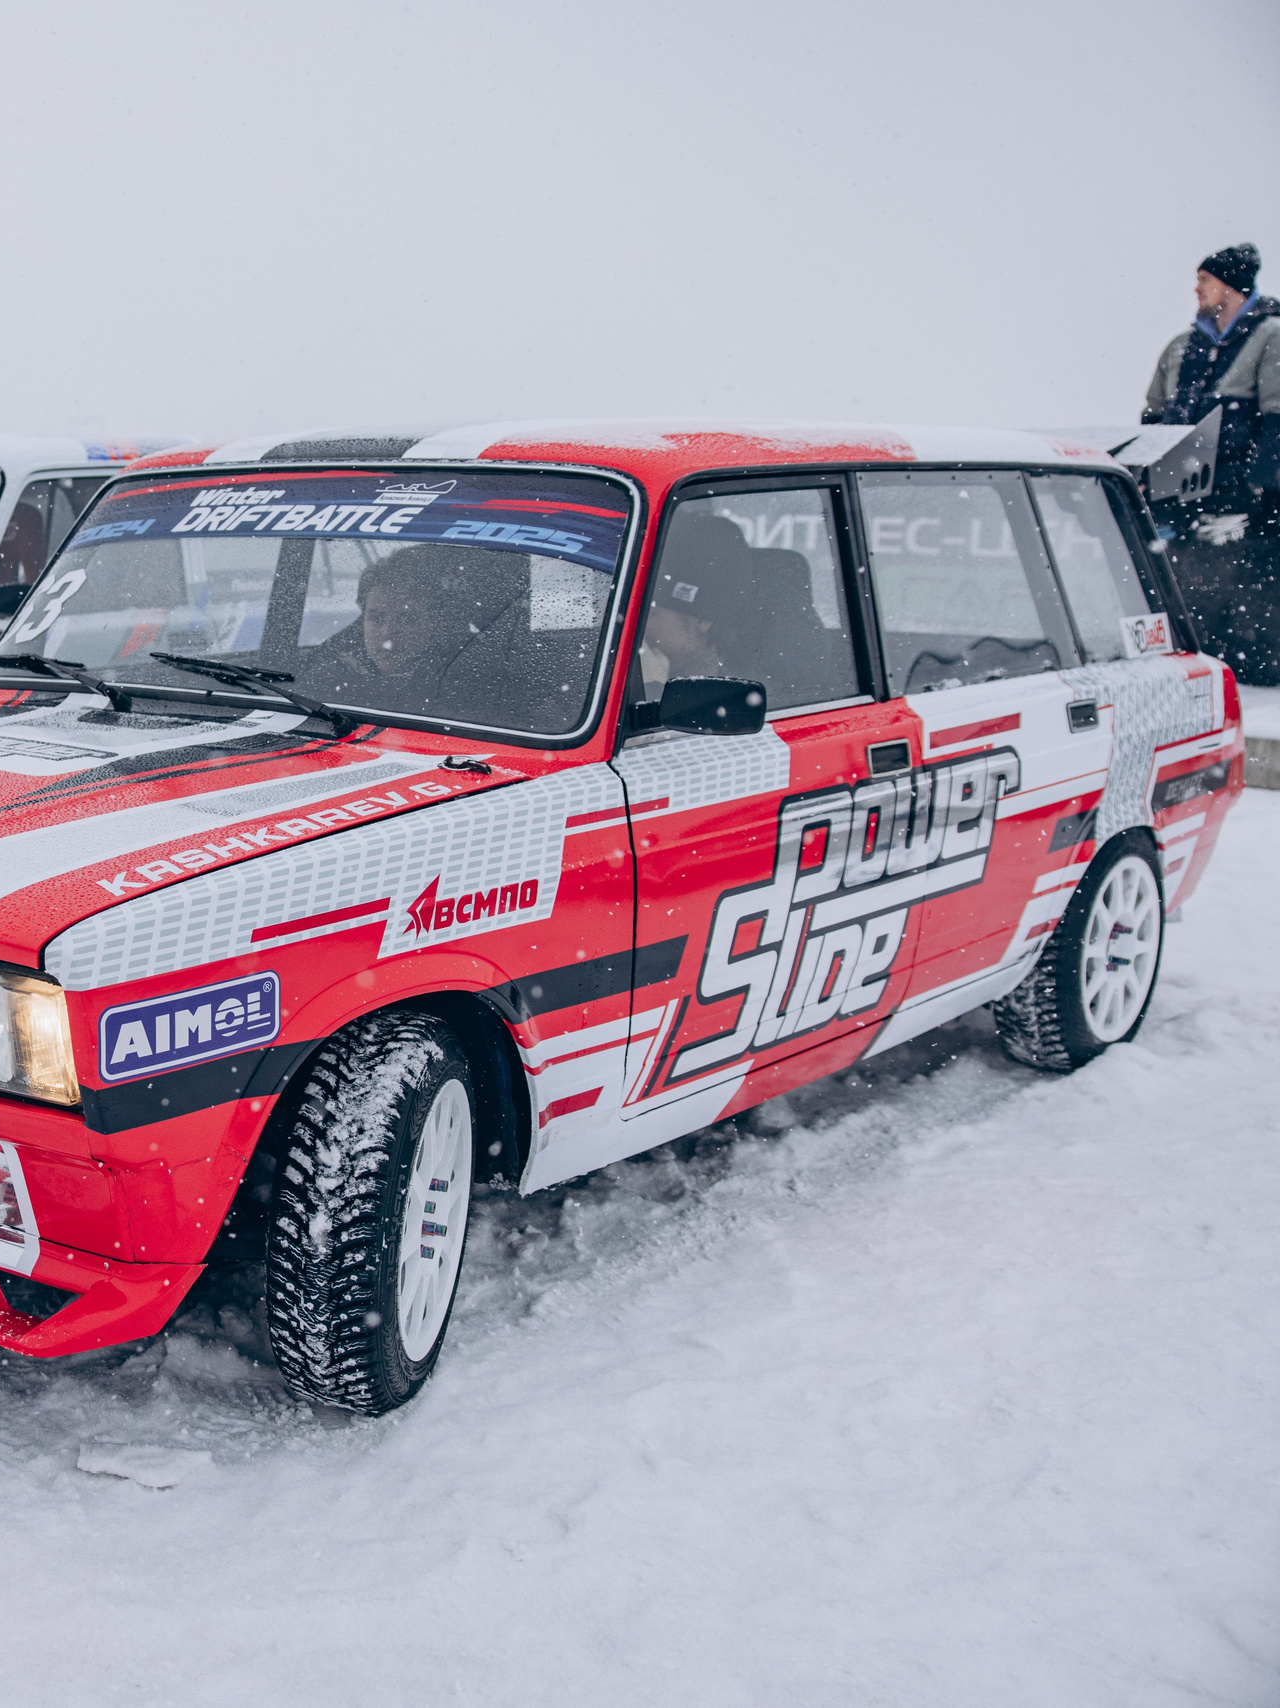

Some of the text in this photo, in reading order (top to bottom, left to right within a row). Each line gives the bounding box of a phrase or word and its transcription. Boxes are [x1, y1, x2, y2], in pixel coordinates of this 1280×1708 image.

[190, 487, 286, 507] Winter
[70, 518, 157, 547] 2024
[170, 504, 425, 534] DRIFTBATTLE
[441, 520, 593, 555] 2025
[96, 790, 410, 897] KASHKAREV
[433, 879, 539, 930] ВСМПО
